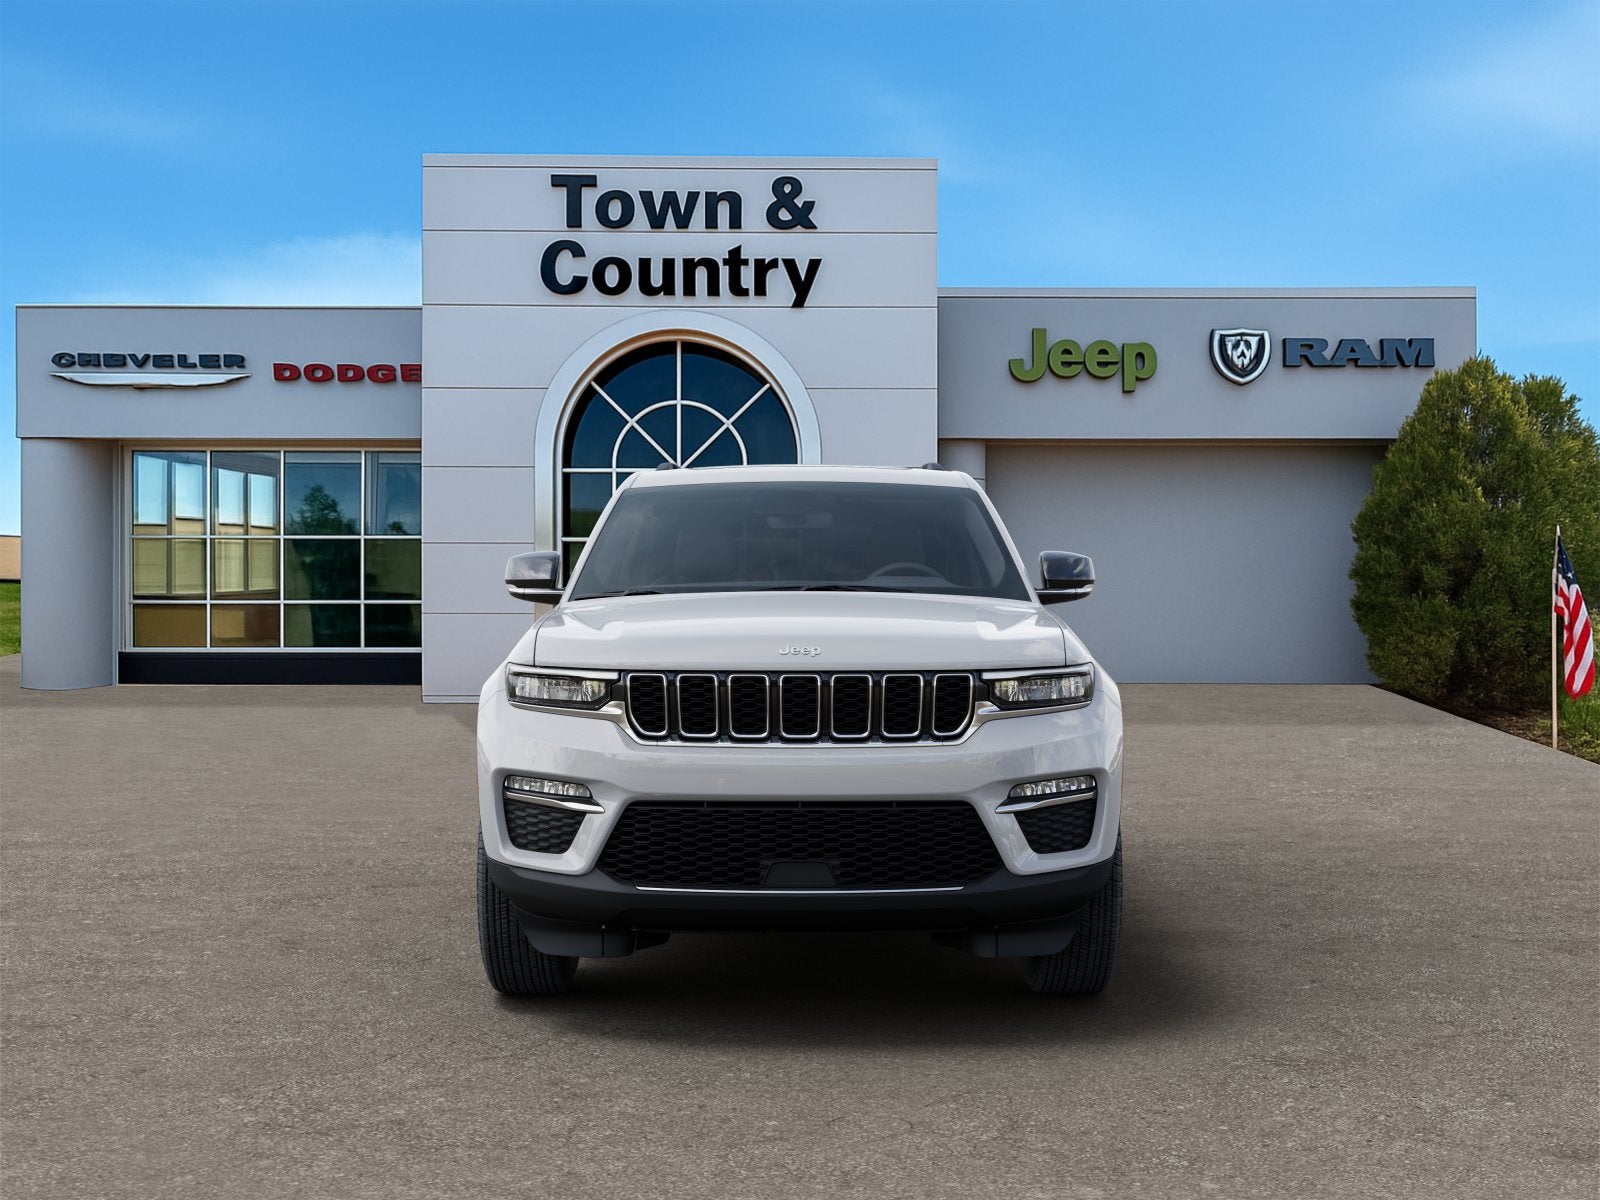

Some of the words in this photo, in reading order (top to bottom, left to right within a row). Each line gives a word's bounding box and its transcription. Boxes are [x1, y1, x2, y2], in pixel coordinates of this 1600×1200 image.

[550, 174, 742, 229] Town
[765, 175, 818, 229] &
[540, 239, 823, 308] Country
[273, 363, 422, 383] DODGE
[1008, 328, 1157, 393] Jeep
[1283, 337, 1435, 367] RAM
[778, 643, 822, 657] Jeep
